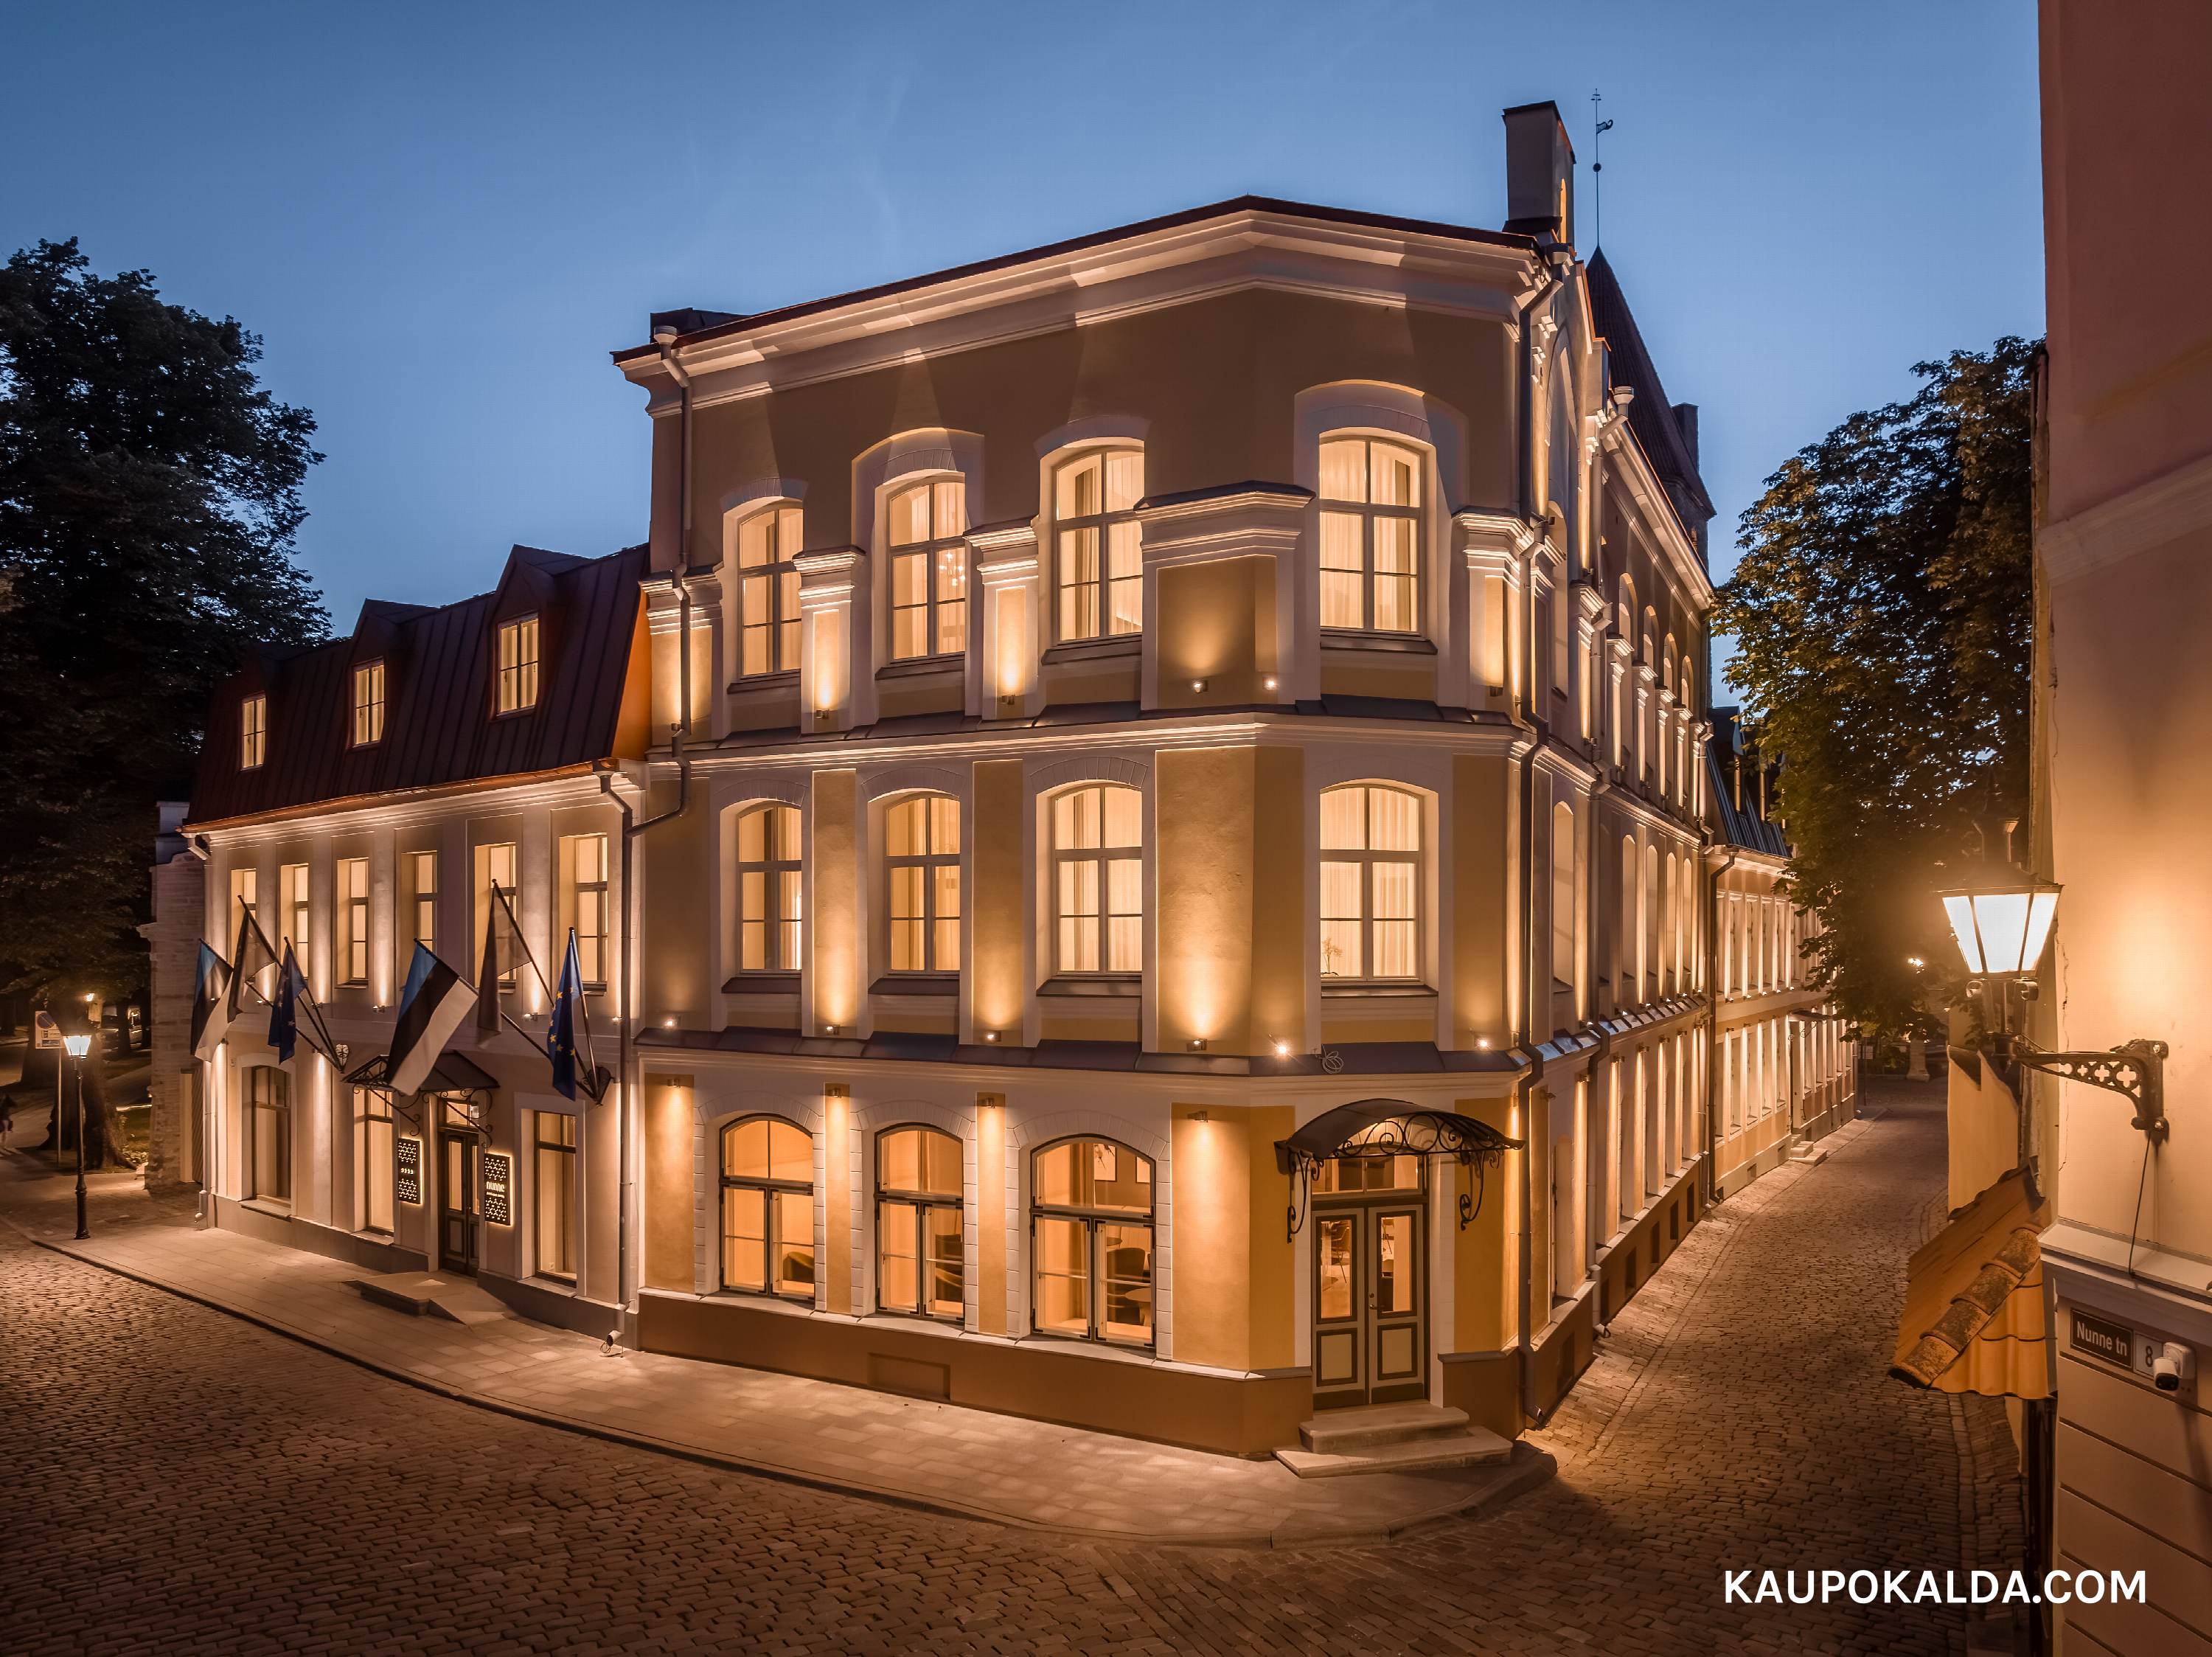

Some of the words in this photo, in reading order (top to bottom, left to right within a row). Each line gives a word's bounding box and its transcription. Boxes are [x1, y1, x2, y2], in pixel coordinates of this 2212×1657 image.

[2076, 1321, 2112, 1351] Nunne
[2115, 1336, 2127, 1357] tn
[2145, 1345, 2153, 1368] 8
